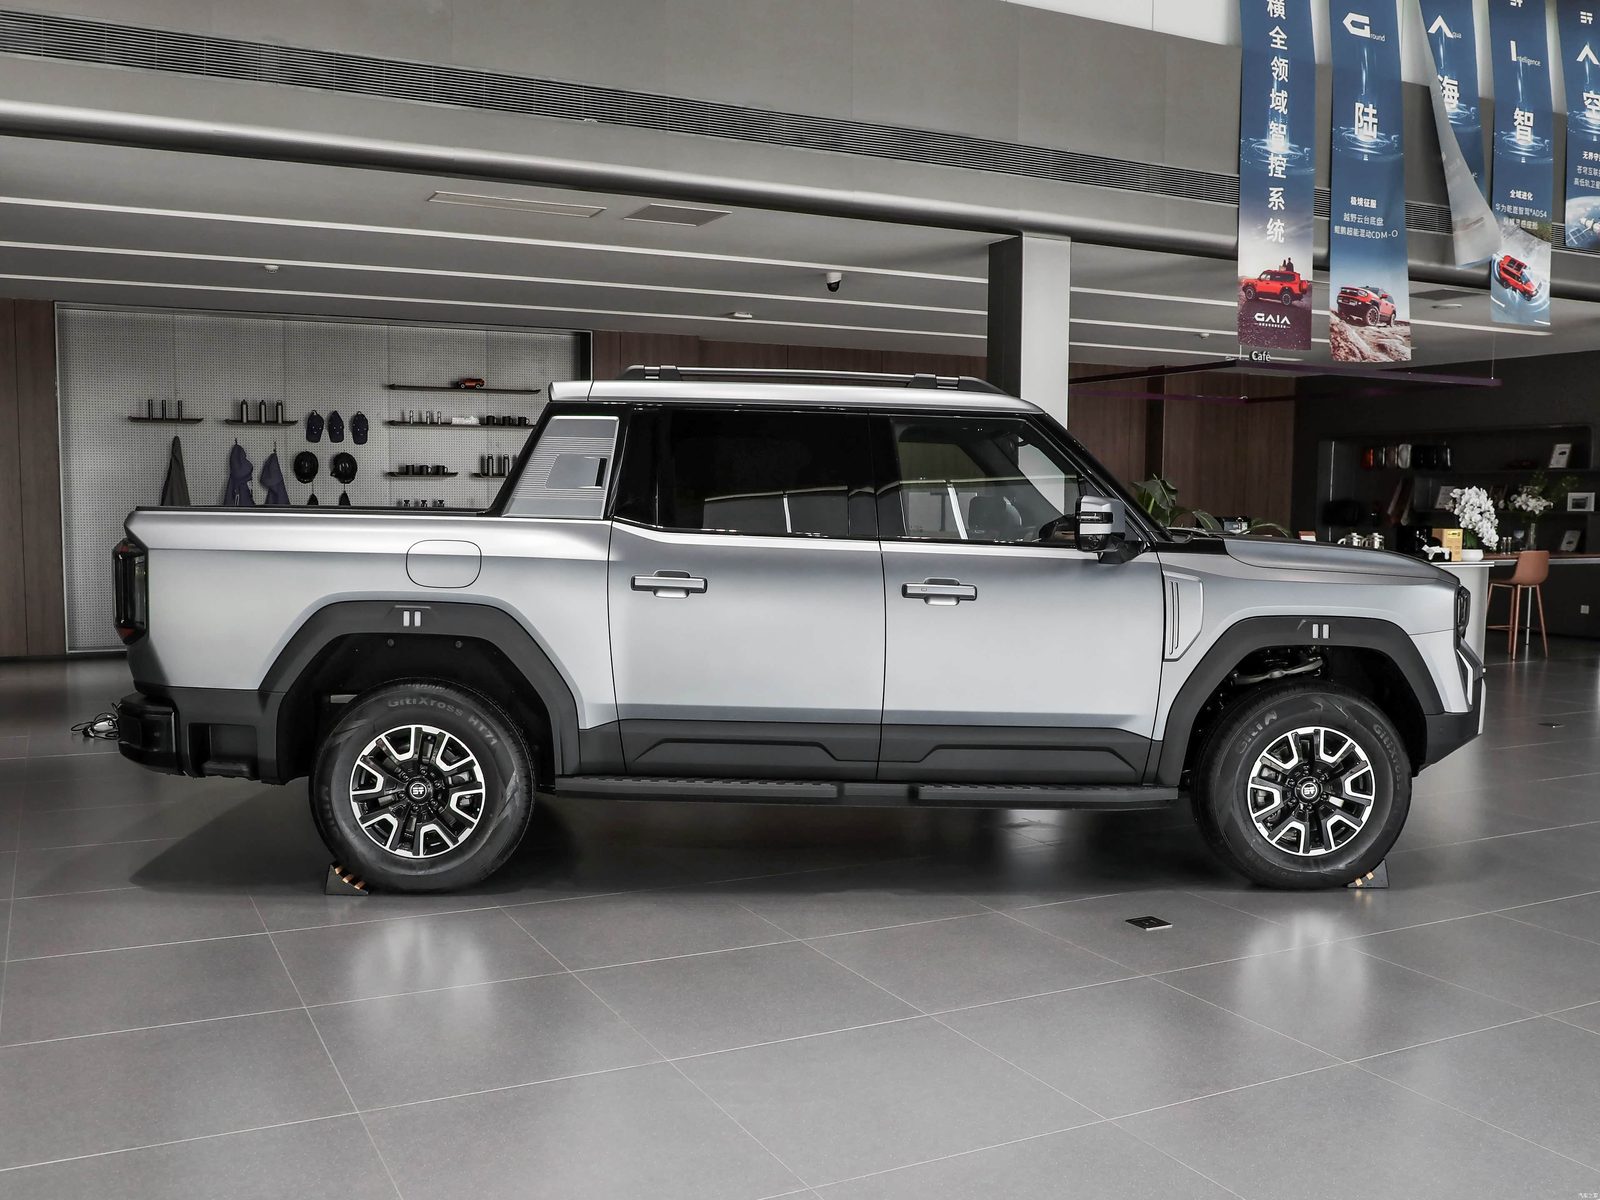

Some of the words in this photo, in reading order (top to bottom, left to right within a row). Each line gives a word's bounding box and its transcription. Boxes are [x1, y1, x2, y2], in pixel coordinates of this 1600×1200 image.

[1354, 102, 1378, 139] 陆
[1513, 107, 1534, 144] 智
[1254, 312, 1291, 325] GAIA
